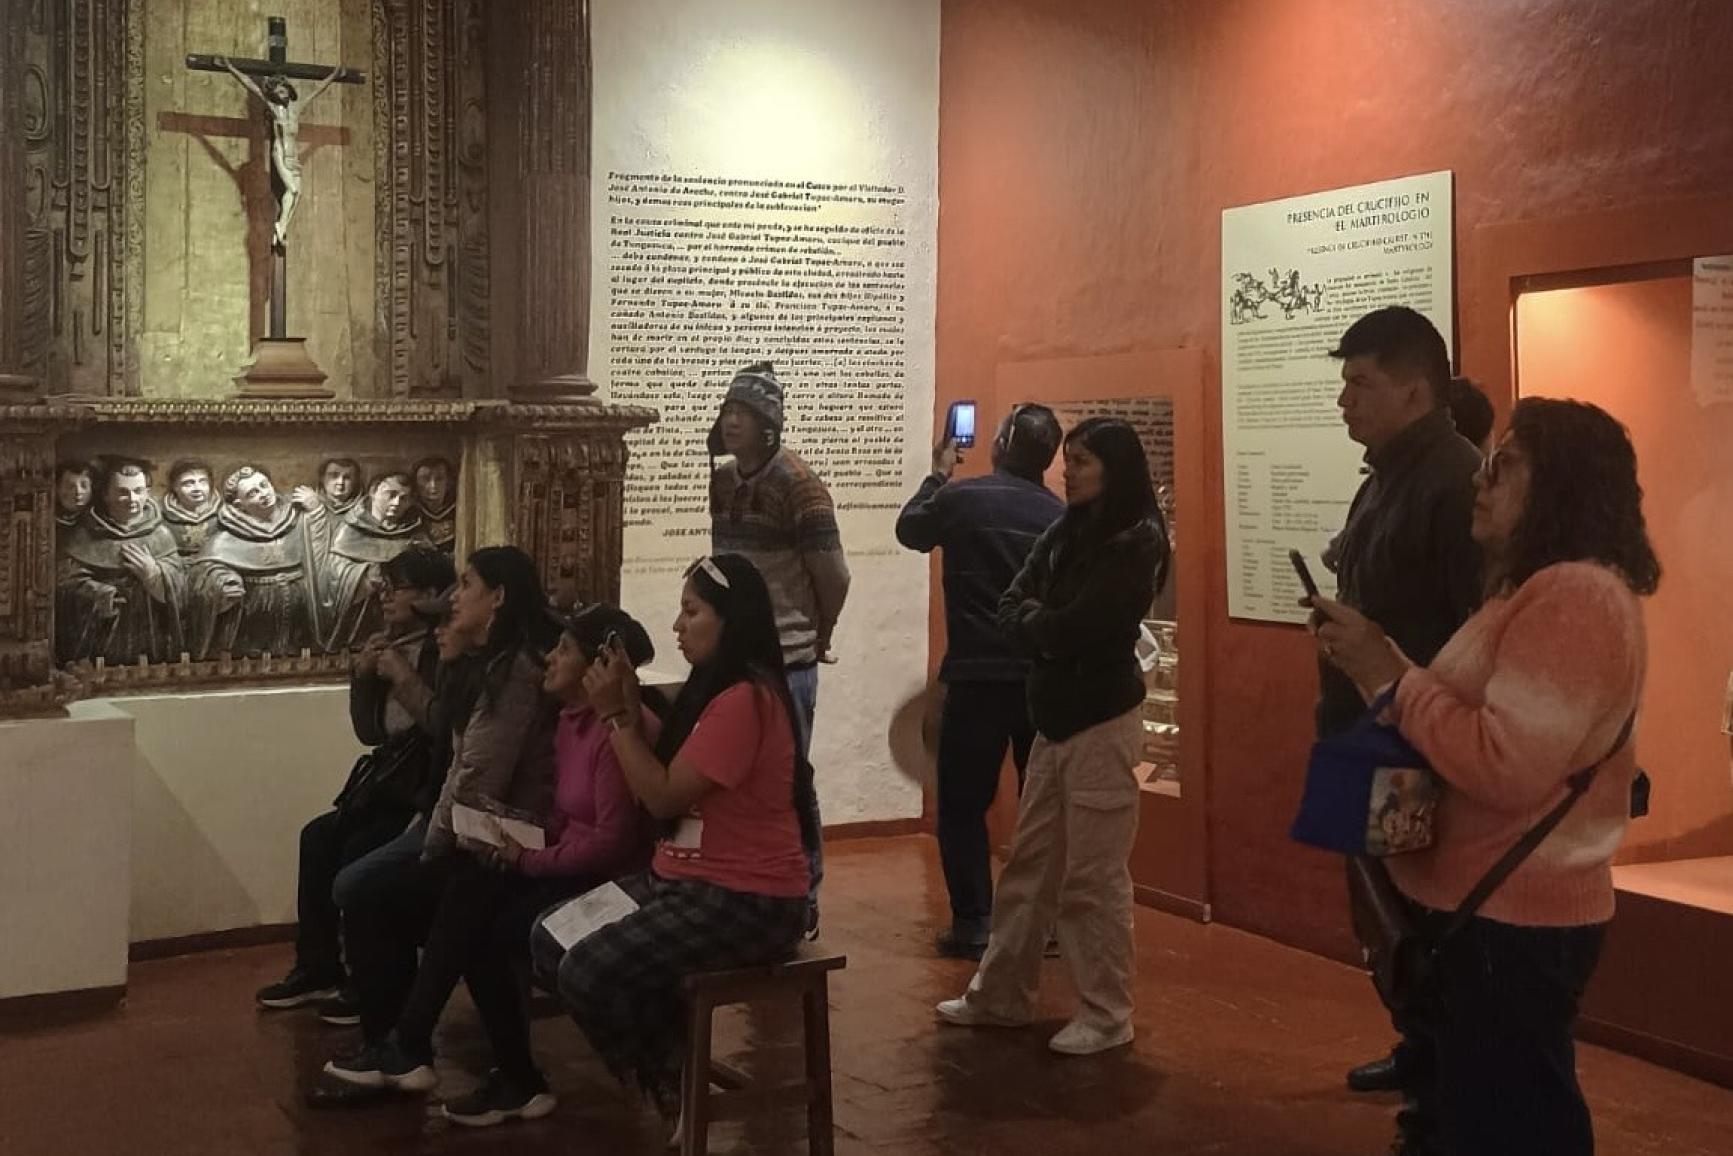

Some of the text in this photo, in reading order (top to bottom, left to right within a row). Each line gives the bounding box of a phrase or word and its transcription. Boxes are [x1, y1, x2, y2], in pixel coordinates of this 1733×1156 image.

[1338, 204, 1355, 217] DEL
[1416, 192, 1429, 204] EN
[1336, 207, 1429, 231] EL MARTIROLOGIO
